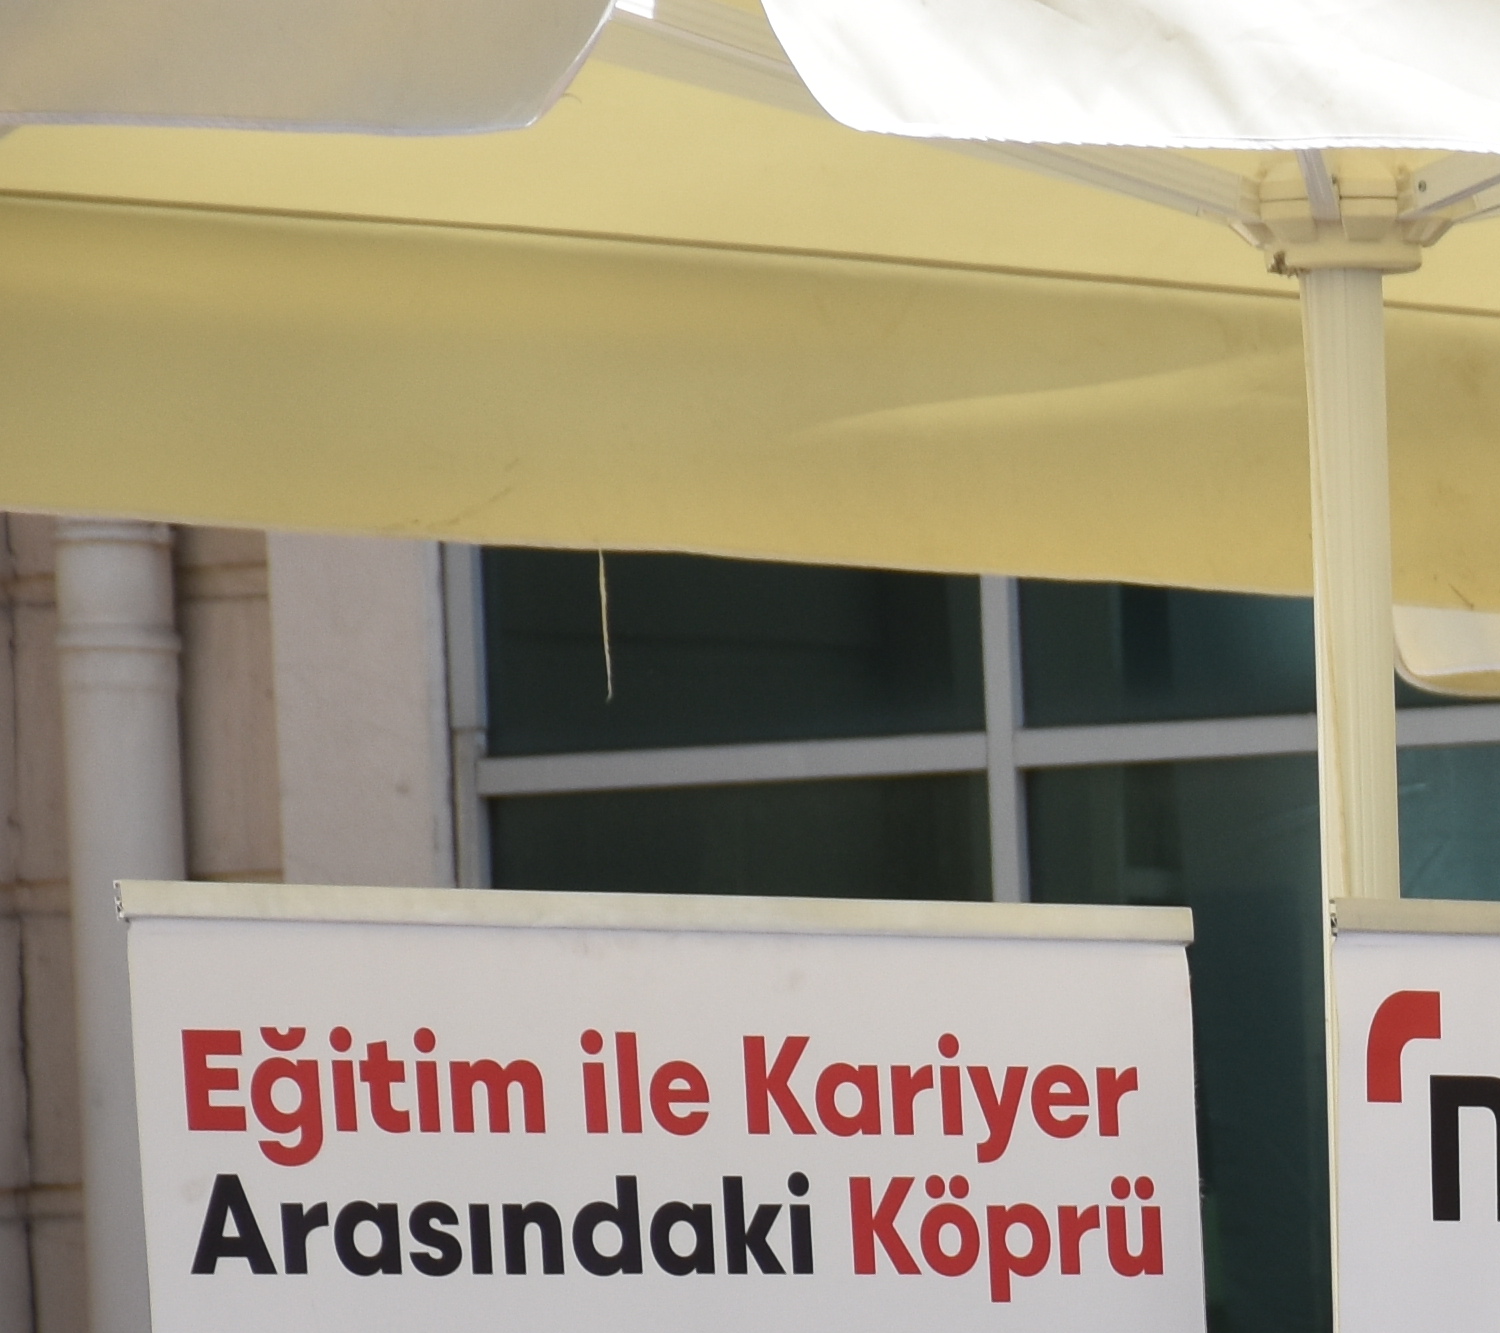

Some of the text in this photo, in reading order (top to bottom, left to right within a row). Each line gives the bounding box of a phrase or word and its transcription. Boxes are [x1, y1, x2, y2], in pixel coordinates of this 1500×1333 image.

[181, 1026, 1139, 1167] Eğitim ile Kariyer
[190, 1171, 1164, 1303] Arasındaki Köprü
